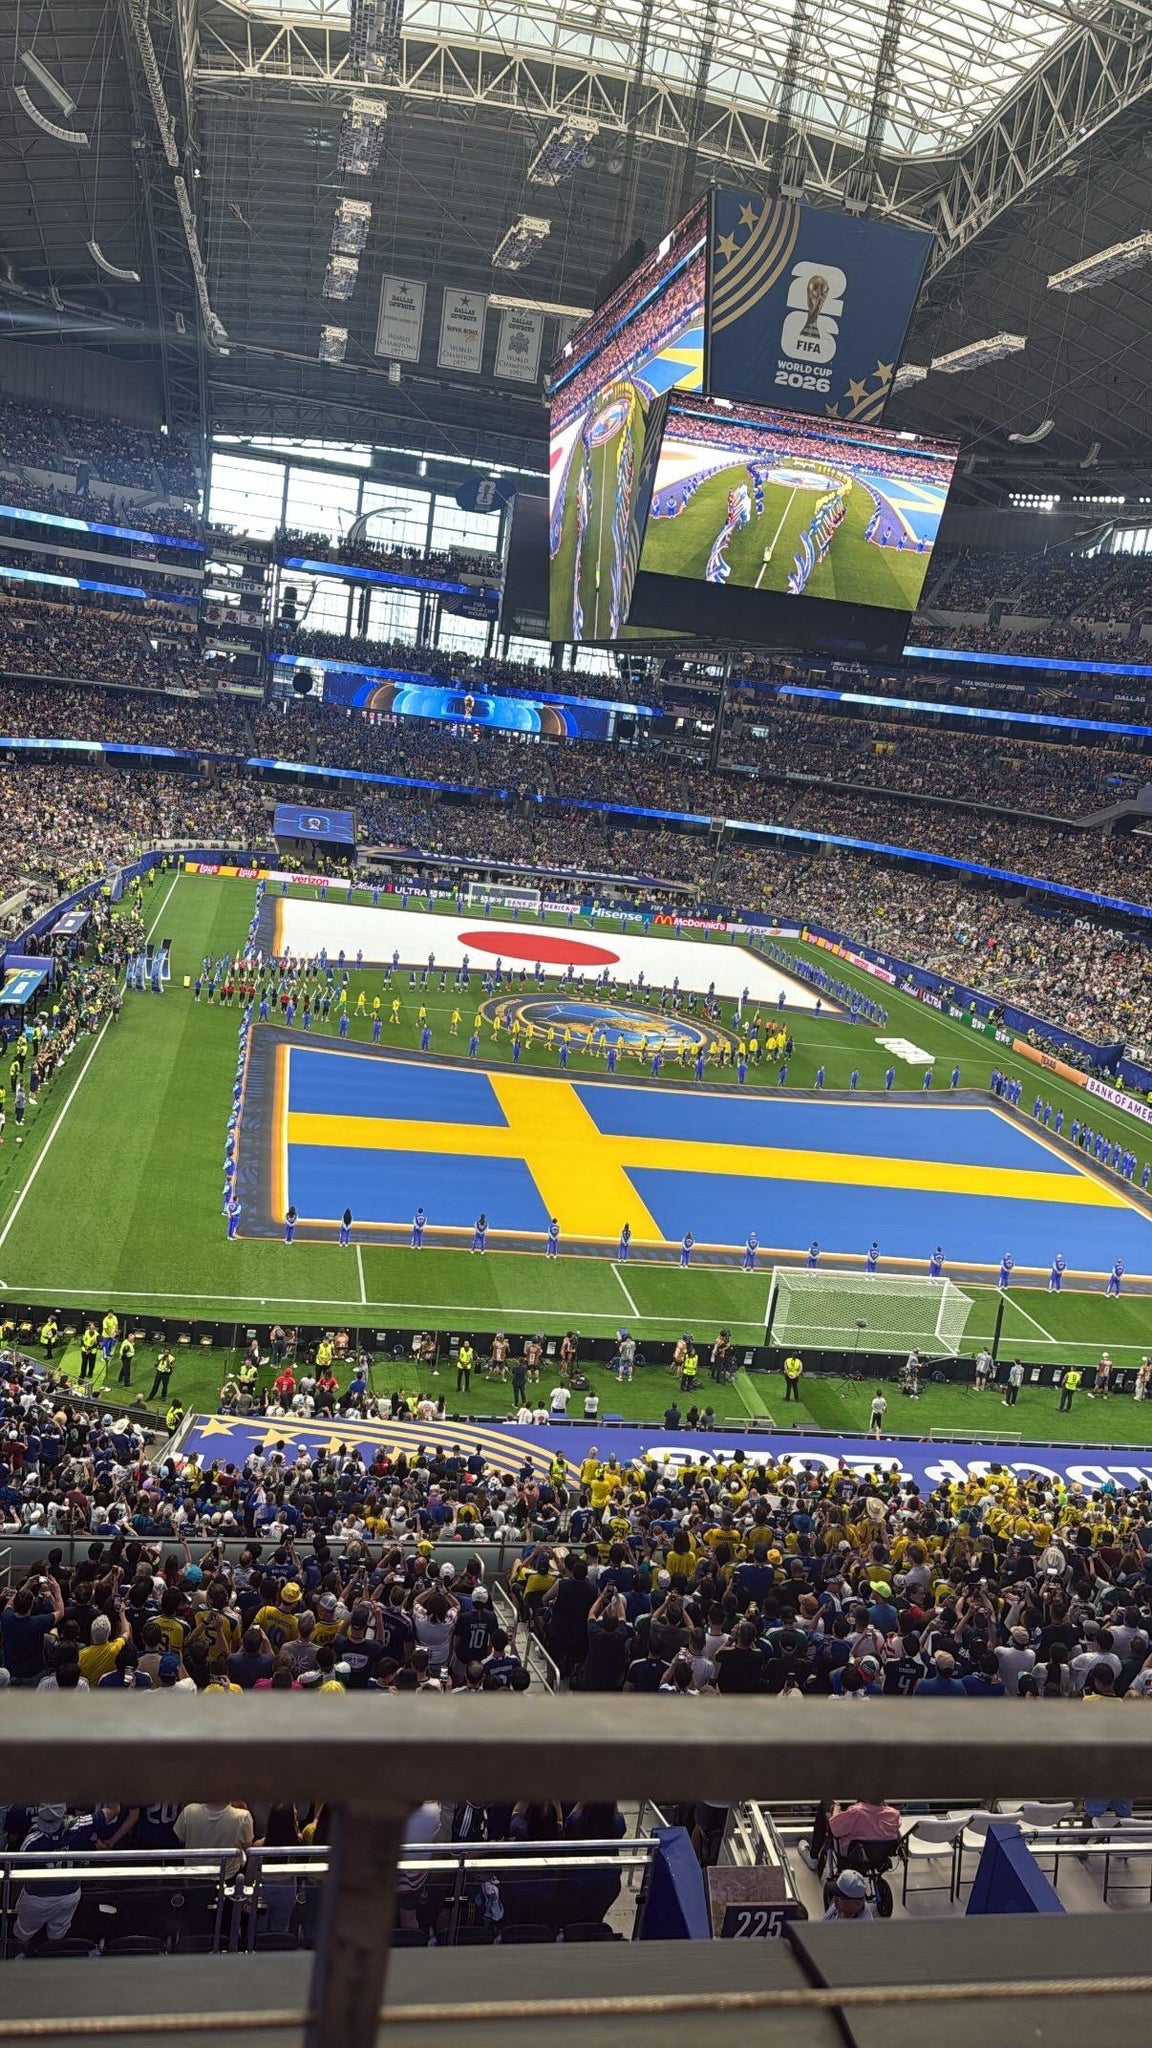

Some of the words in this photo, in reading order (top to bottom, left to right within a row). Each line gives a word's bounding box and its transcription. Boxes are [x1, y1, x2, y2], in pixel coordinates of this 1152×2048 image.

[453, 307, 475, 315] DALLAS
[450, 313, 478, 322] COWBOYS
[511, 317, 533, 326] DALLAS
[387, 332, 411, 341] WORLD
[379, 338, 416, 350] CHAMPIONS
[796, 340, 821, 353] FIFA
[507, 354, 529, 363] WORLD
[778, 360, 812, 374] WORLD
[813, 366, 833, 377] CUP
[774, 371, 831, 393] 2026
[832, 665, 868, 673] DALLAS
[1114, 694, 1146, 702] DALLAS
[291, 875, 329, 887] verizon
[395, 886, 427, 897] ULTRA
[591, 907, 642, 920] Hisense
[675, 918, 726, 931] McDonald's
[923, 992, 942, 1010] ULTRA
[1041, 1055, 1057, 1070] TEXAS
[1090, 1080, 1112, 1099] BANK
[1115, 1094, 1126, 1106] OF
[469, 1629, 486, 1649] 10
[733, 1911, 785, 1939] 225
